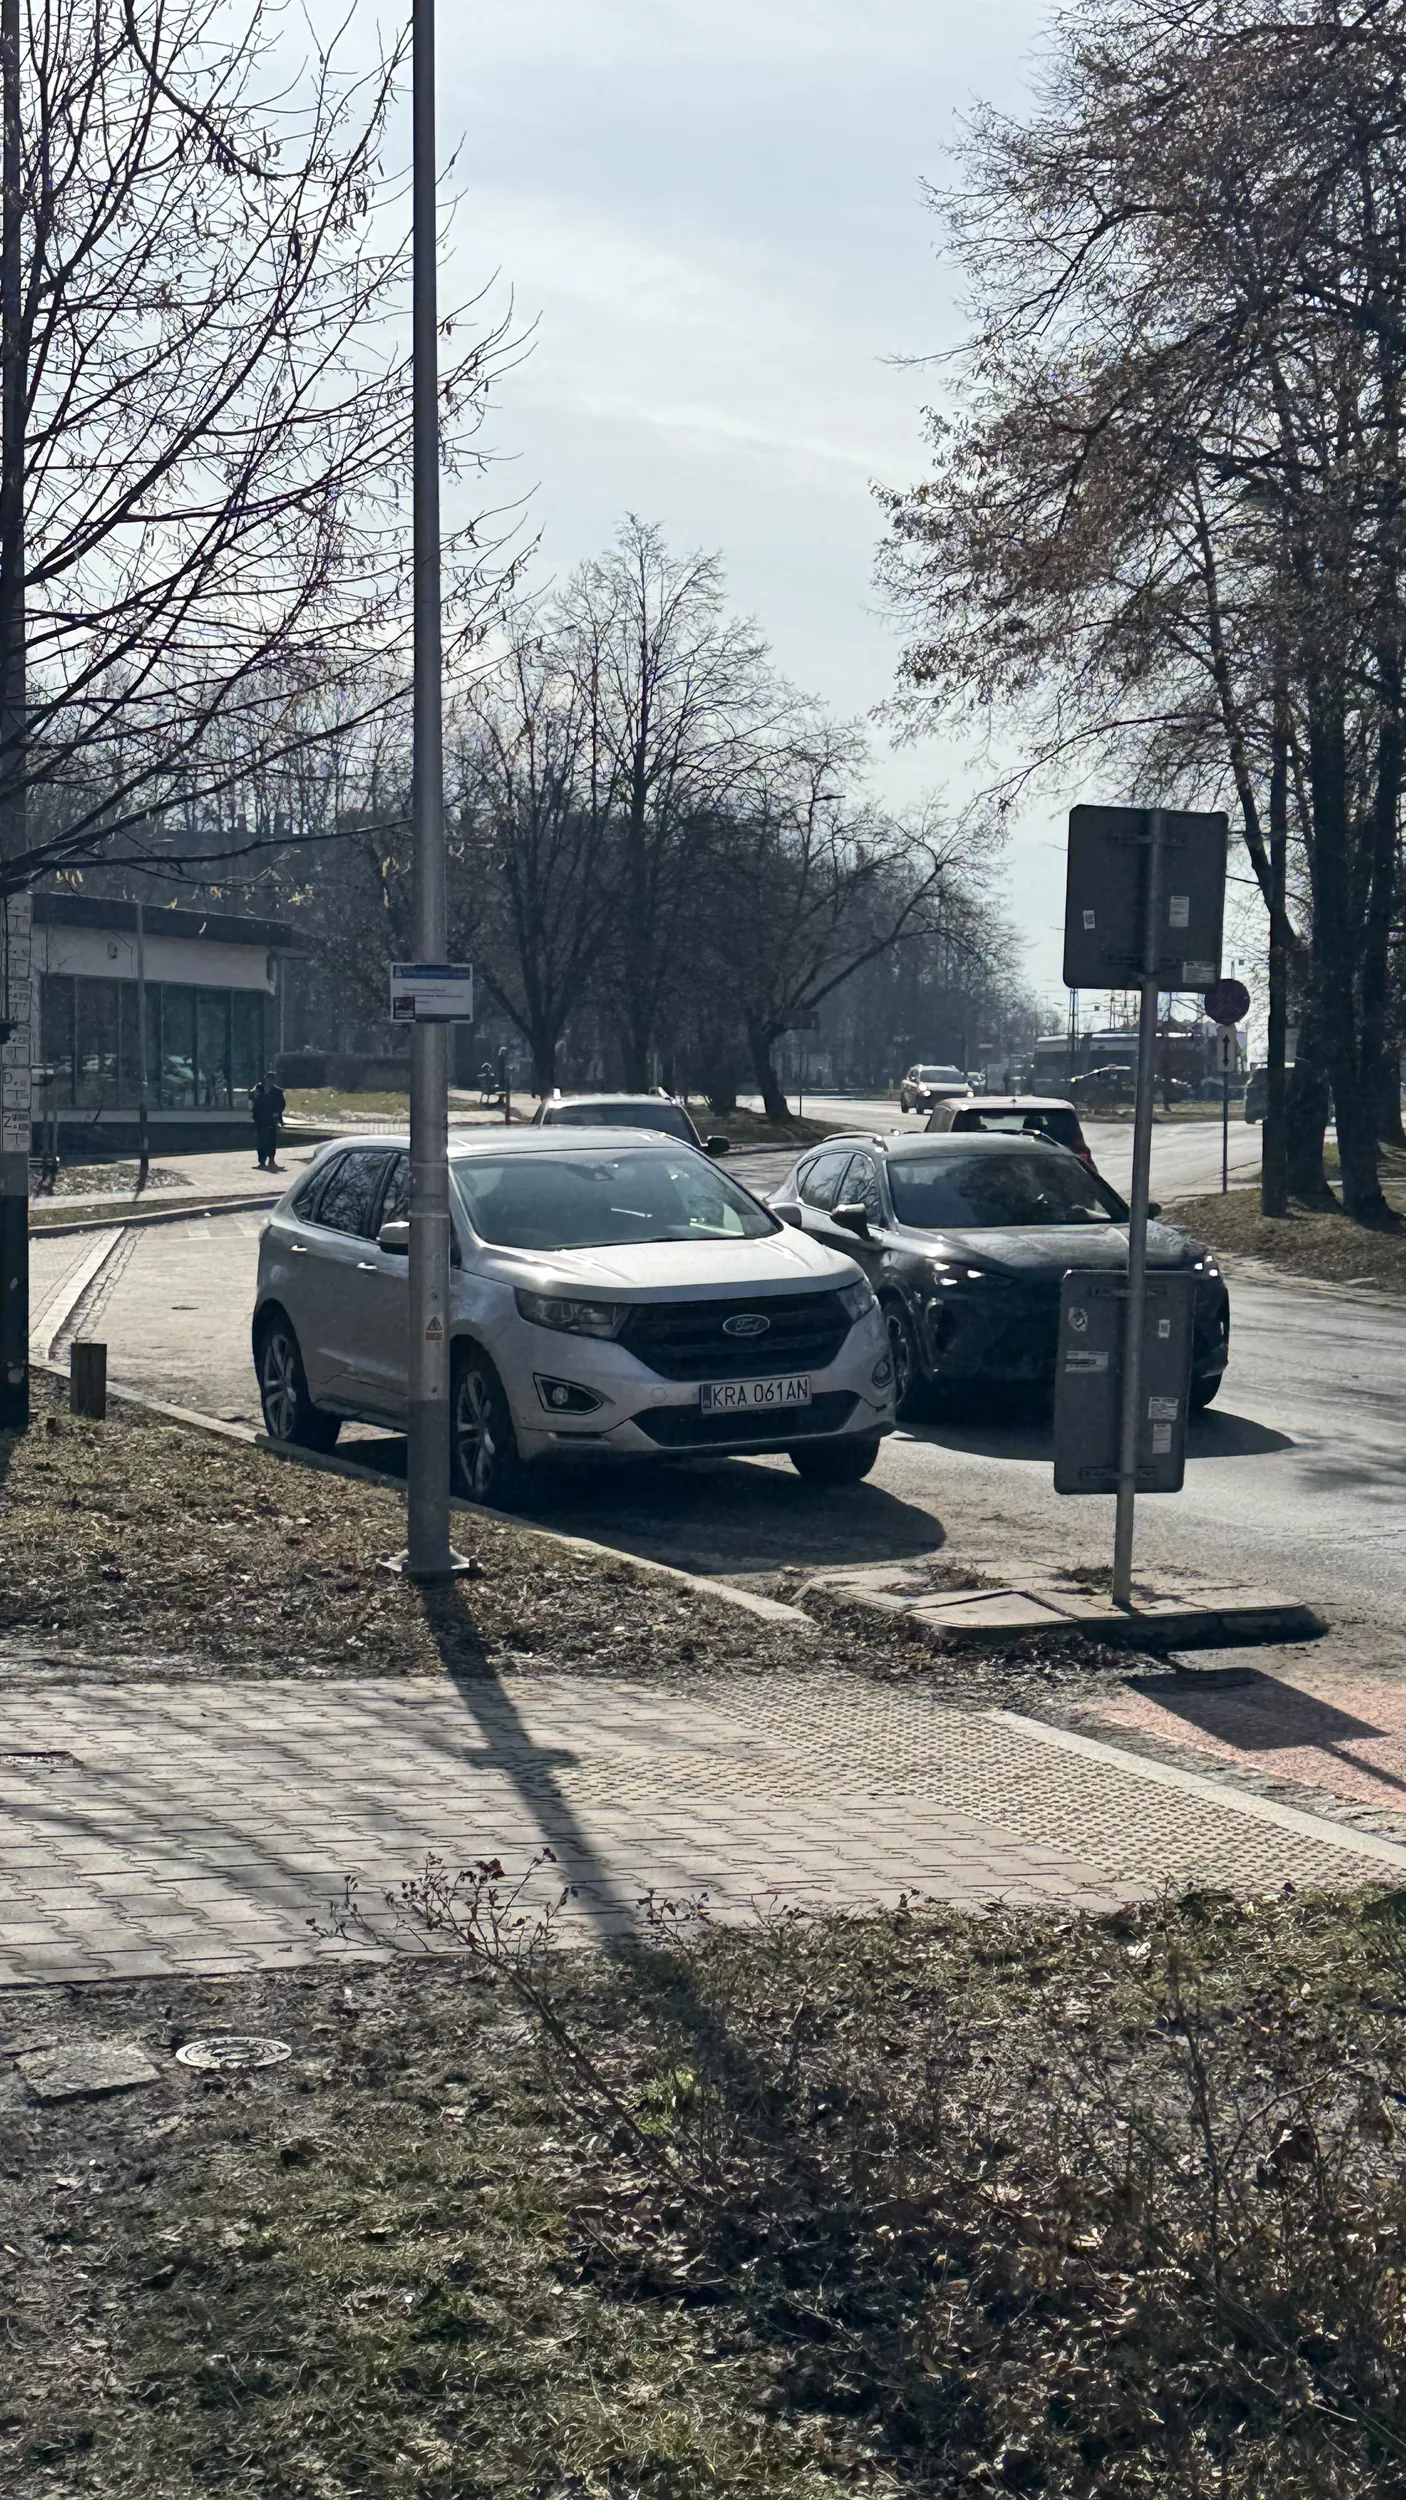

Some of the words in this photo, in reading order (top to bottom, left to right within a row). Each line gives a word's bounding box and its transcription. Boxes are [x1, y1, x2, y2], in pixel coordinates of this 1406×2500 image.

[735, 1318, 761, 1331] Ford
[713, 1386, 747, 1406] KRA
[754, 1379, 808, 1402] 061AN
